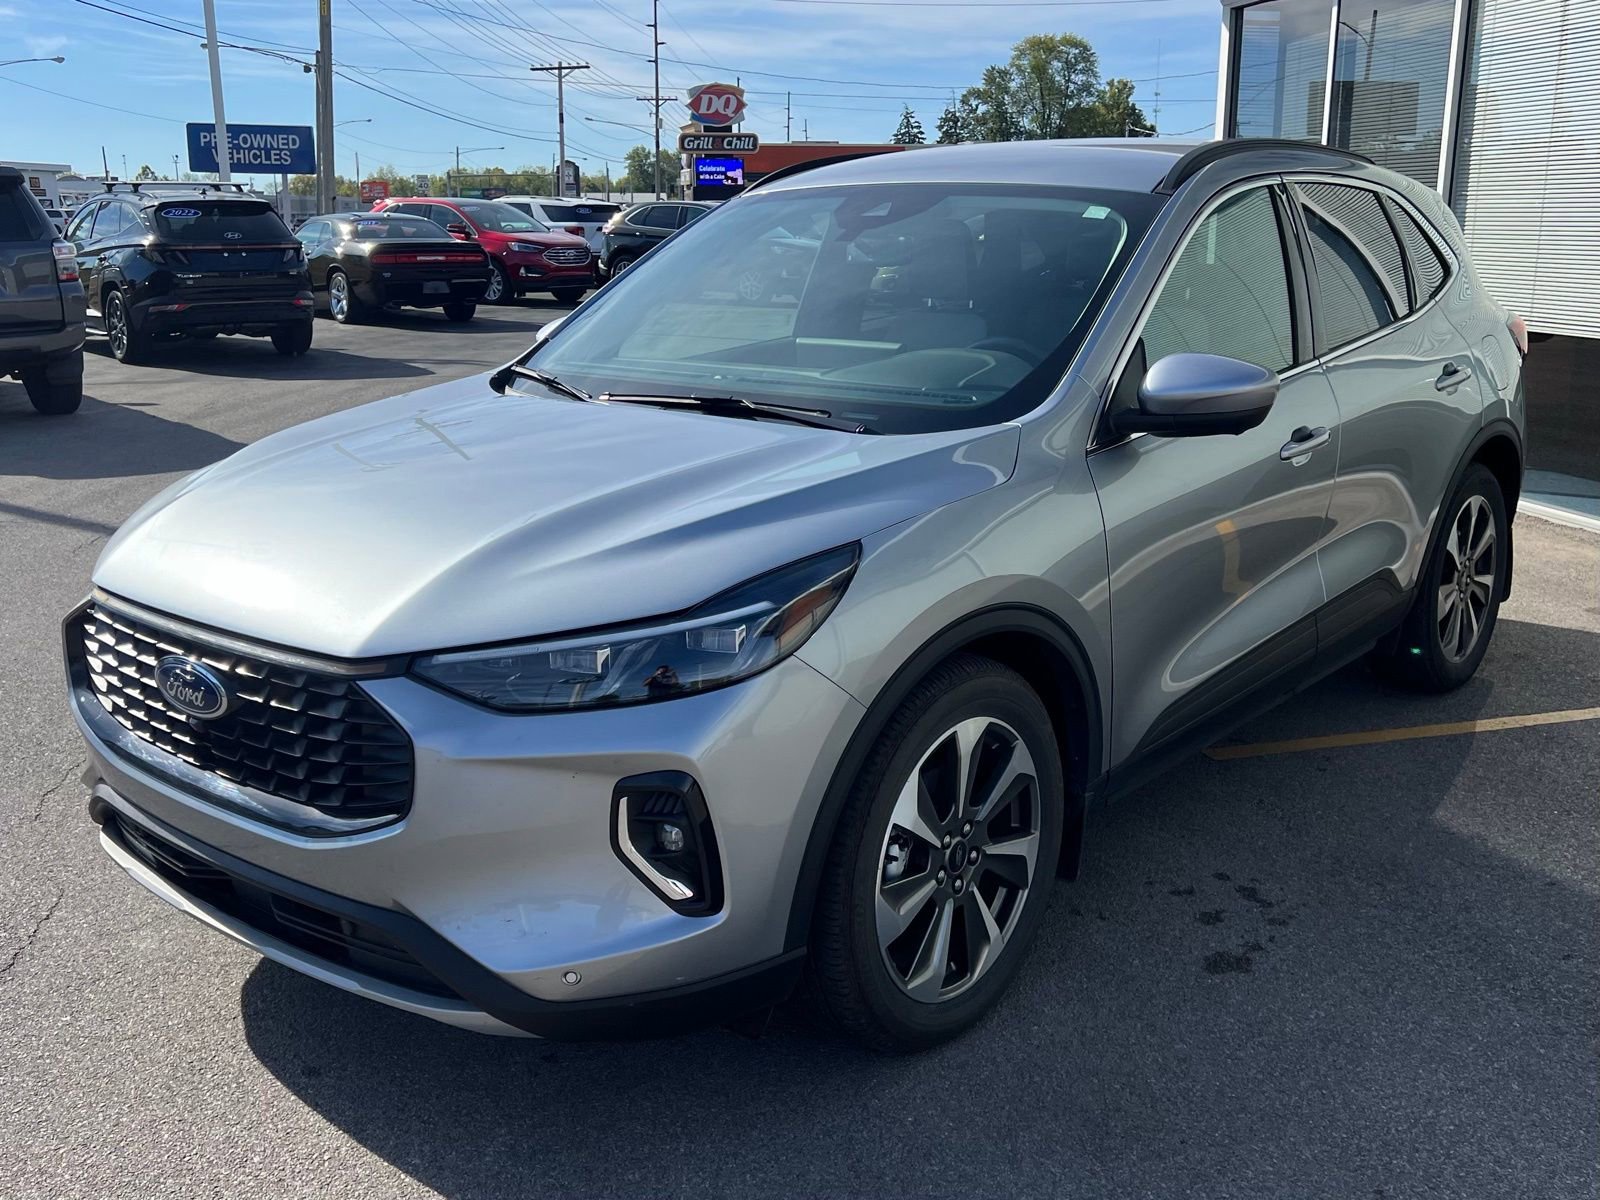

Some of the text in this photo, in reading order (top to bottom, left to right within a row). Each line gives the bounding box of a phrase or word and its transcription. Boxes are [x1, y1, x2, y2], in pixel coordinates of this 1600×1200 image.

[699, 94, 738, 117] DQ
[683, 136, 713, 149] Grill
[723, 136, 754, 149] Chill
[166, 669, 206, 707] Ford
